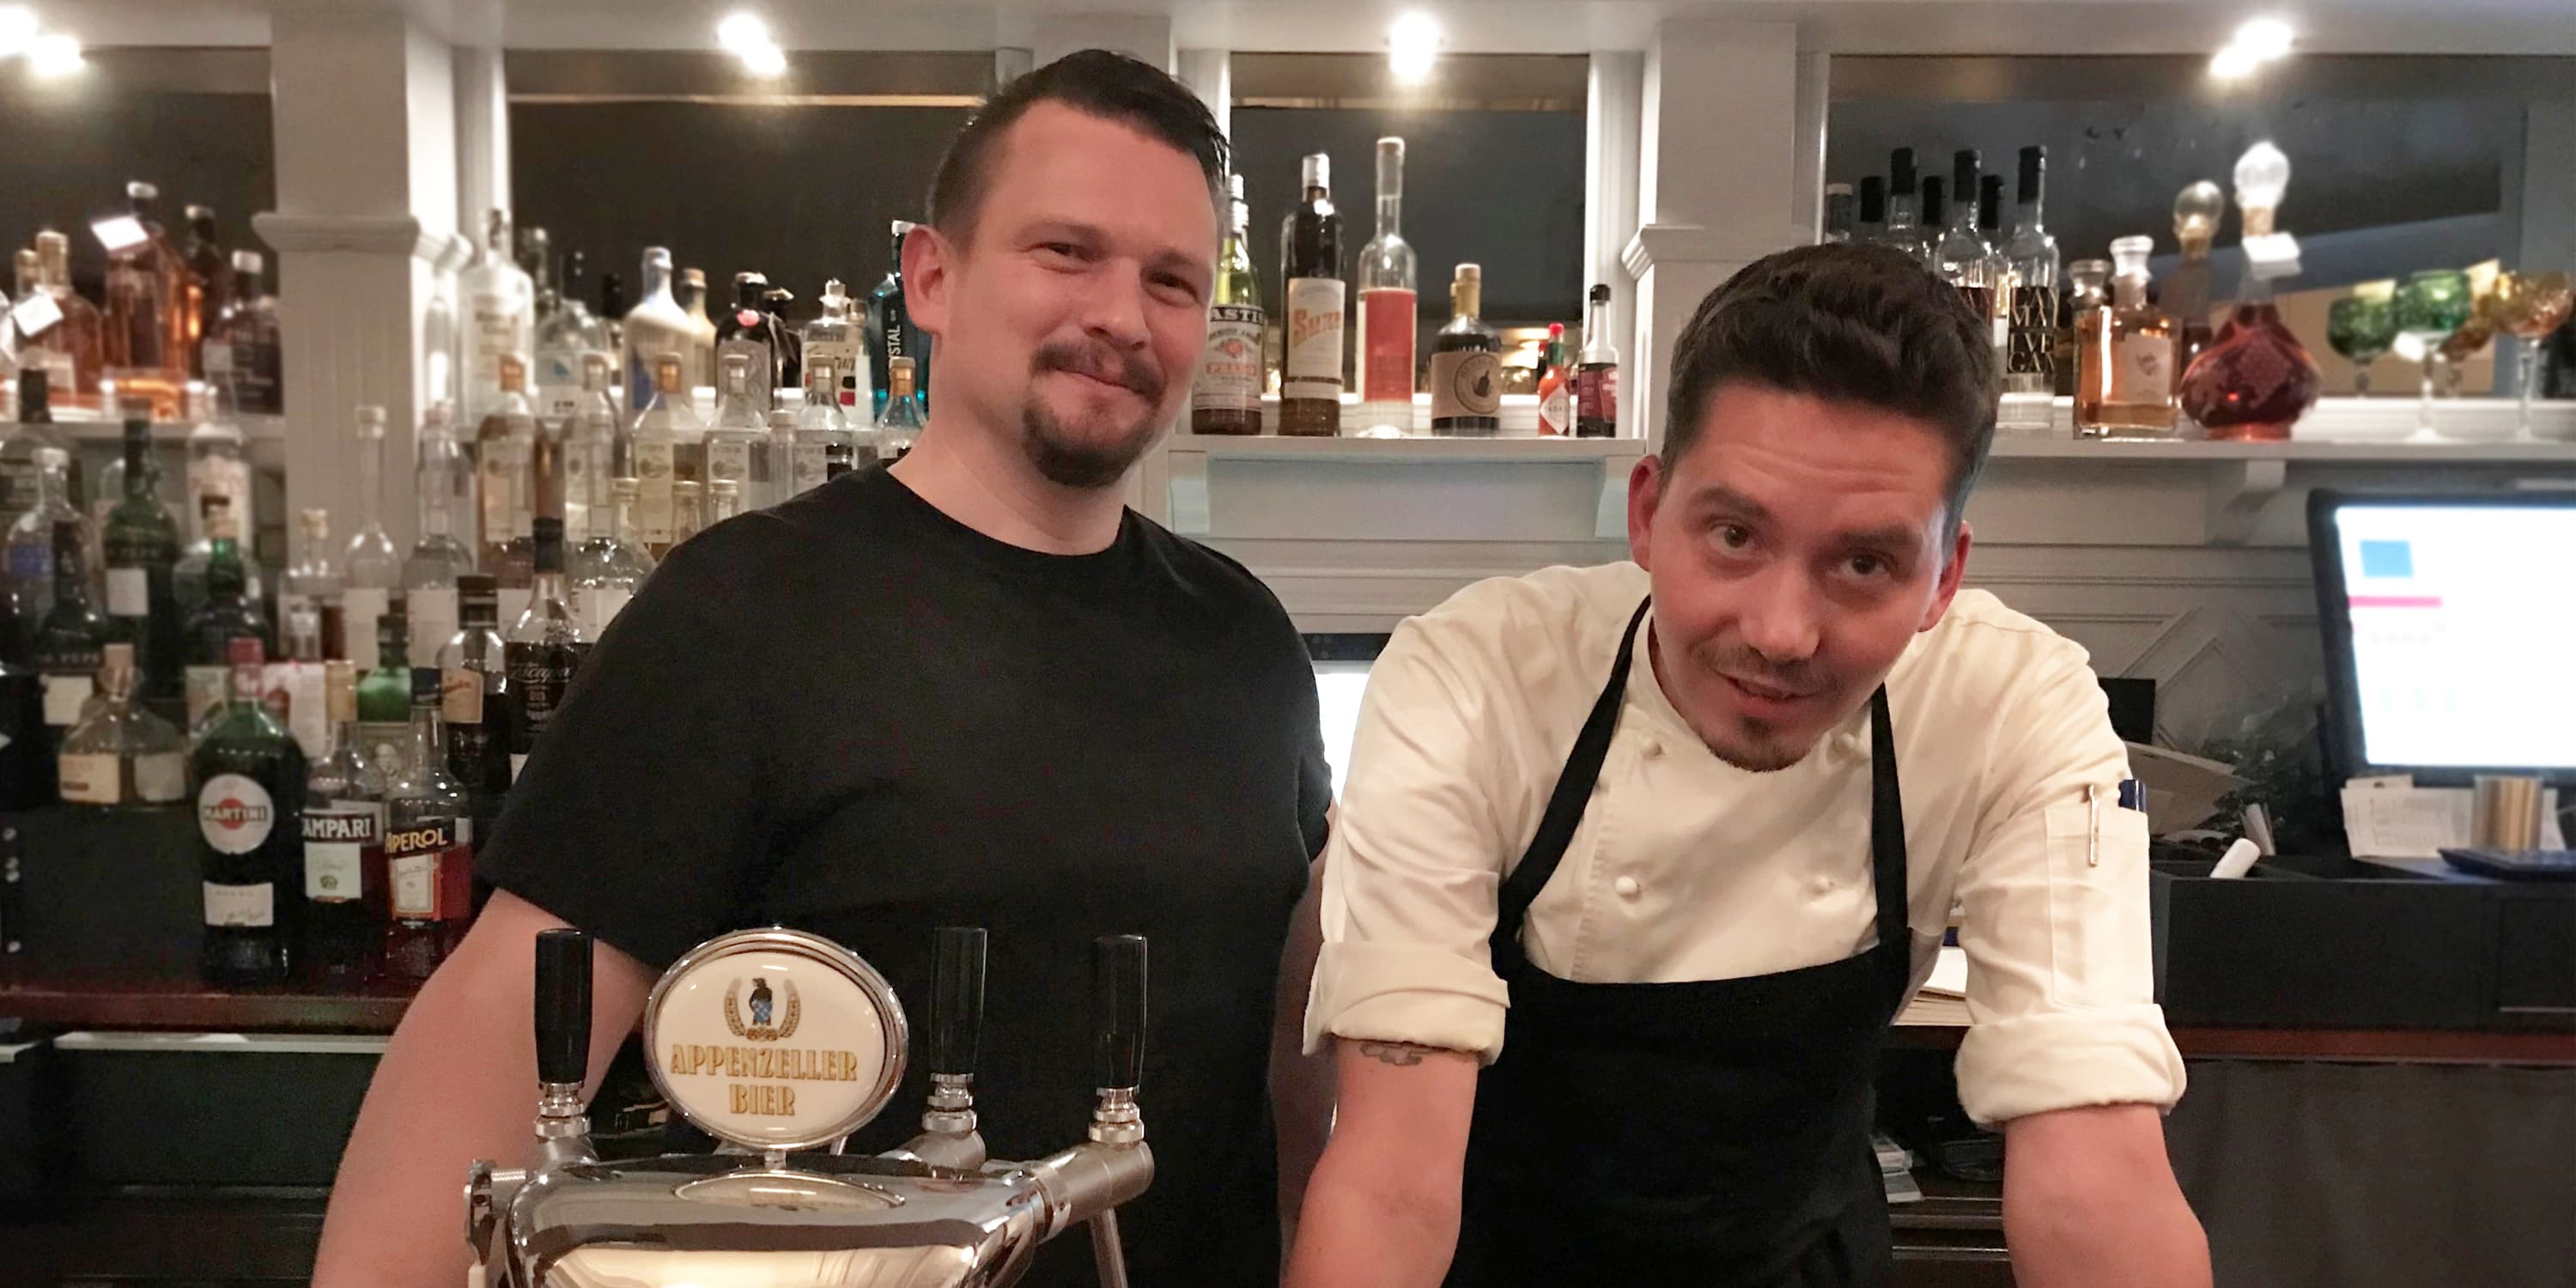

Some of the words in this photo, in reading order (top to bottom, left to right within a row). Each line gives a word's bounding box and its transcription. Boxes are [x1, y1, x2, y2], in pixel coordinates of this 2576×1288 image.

[887, 325, 901, 358] STAL
[204, 807, 267, 821] MARTINI
[301, 817, 372, 839] AMPARI
[671, 1043, 858, 1081] APPENZELLER
[729, 1084, 795, 1116] BIER
